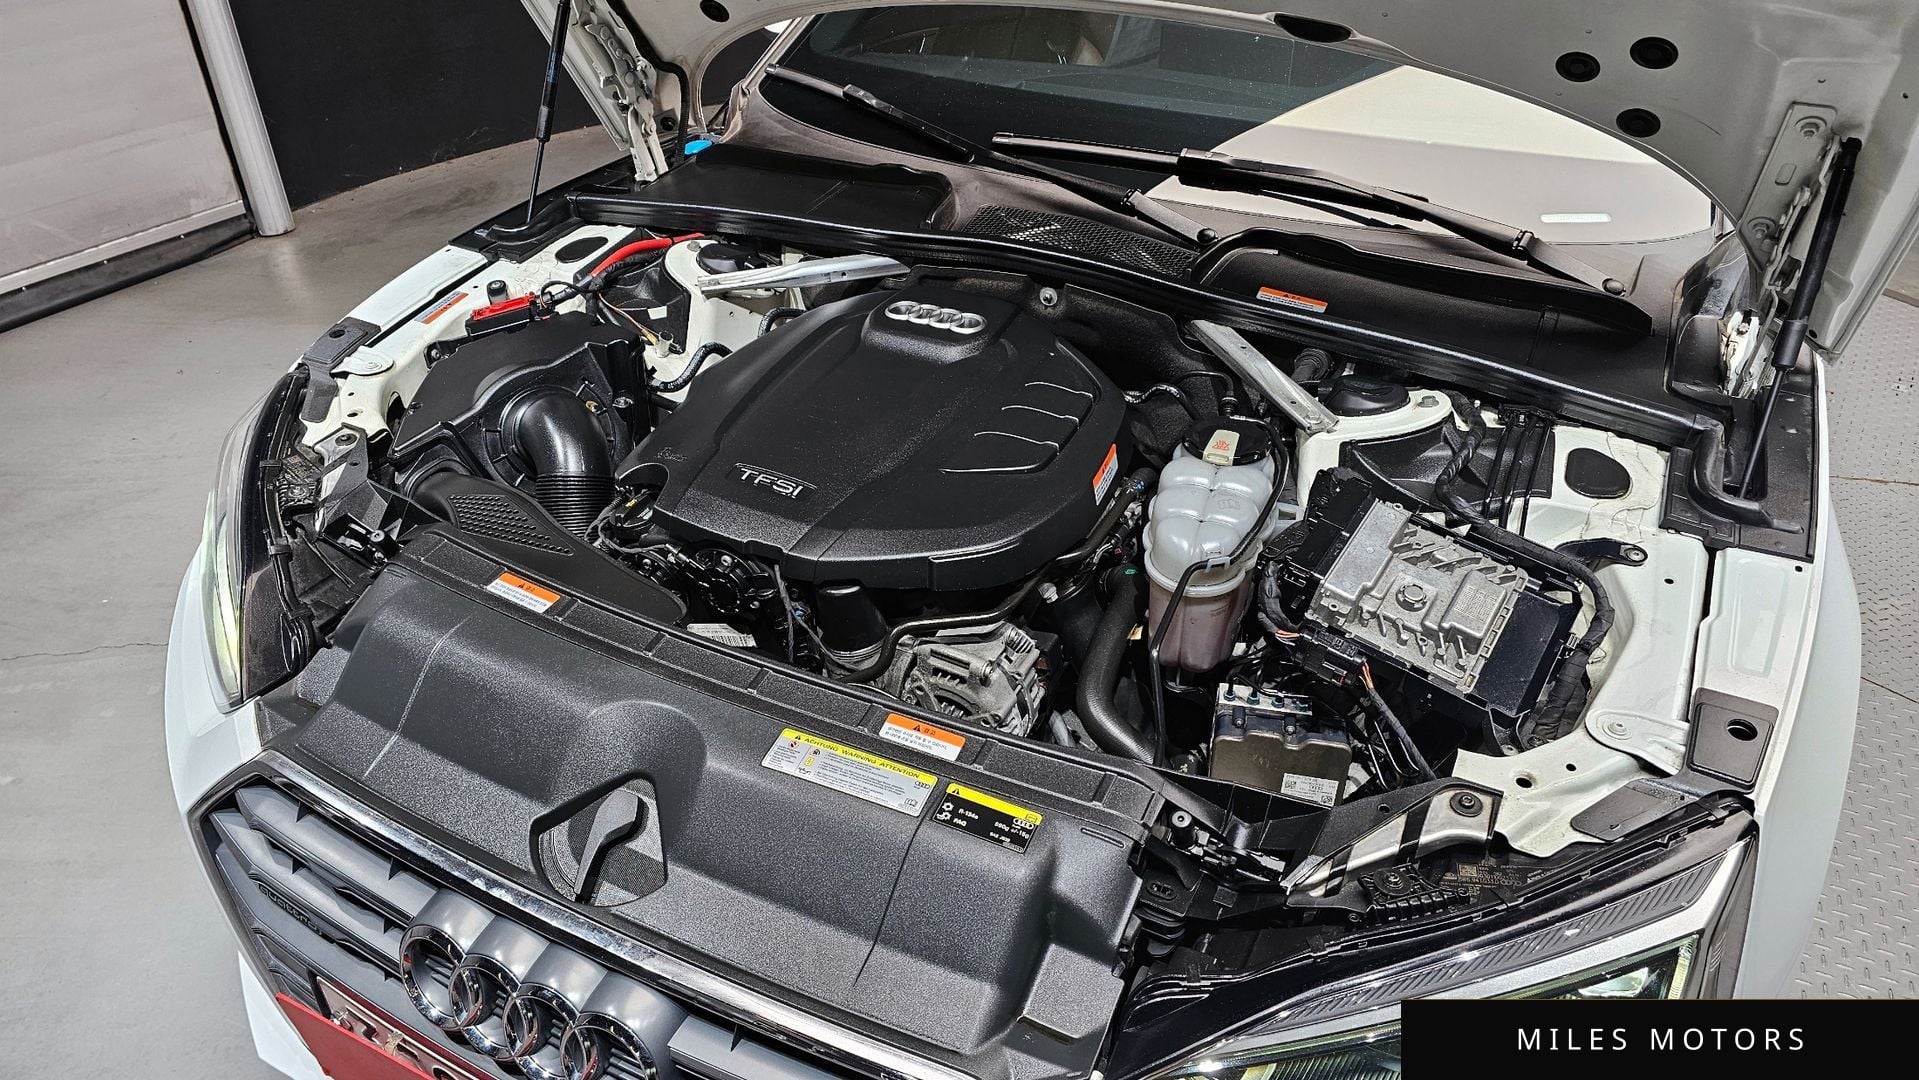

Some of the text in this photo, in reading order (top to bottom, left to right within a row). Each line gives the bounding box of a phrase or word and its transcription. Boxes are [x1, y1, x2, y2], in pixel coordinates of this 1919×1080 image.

[740, 468, 804, 498] TFSI
[804, 738, 921, 779] ACHTUNG WARNING ATTENTION
[258, 884, 319, 931] quattro
